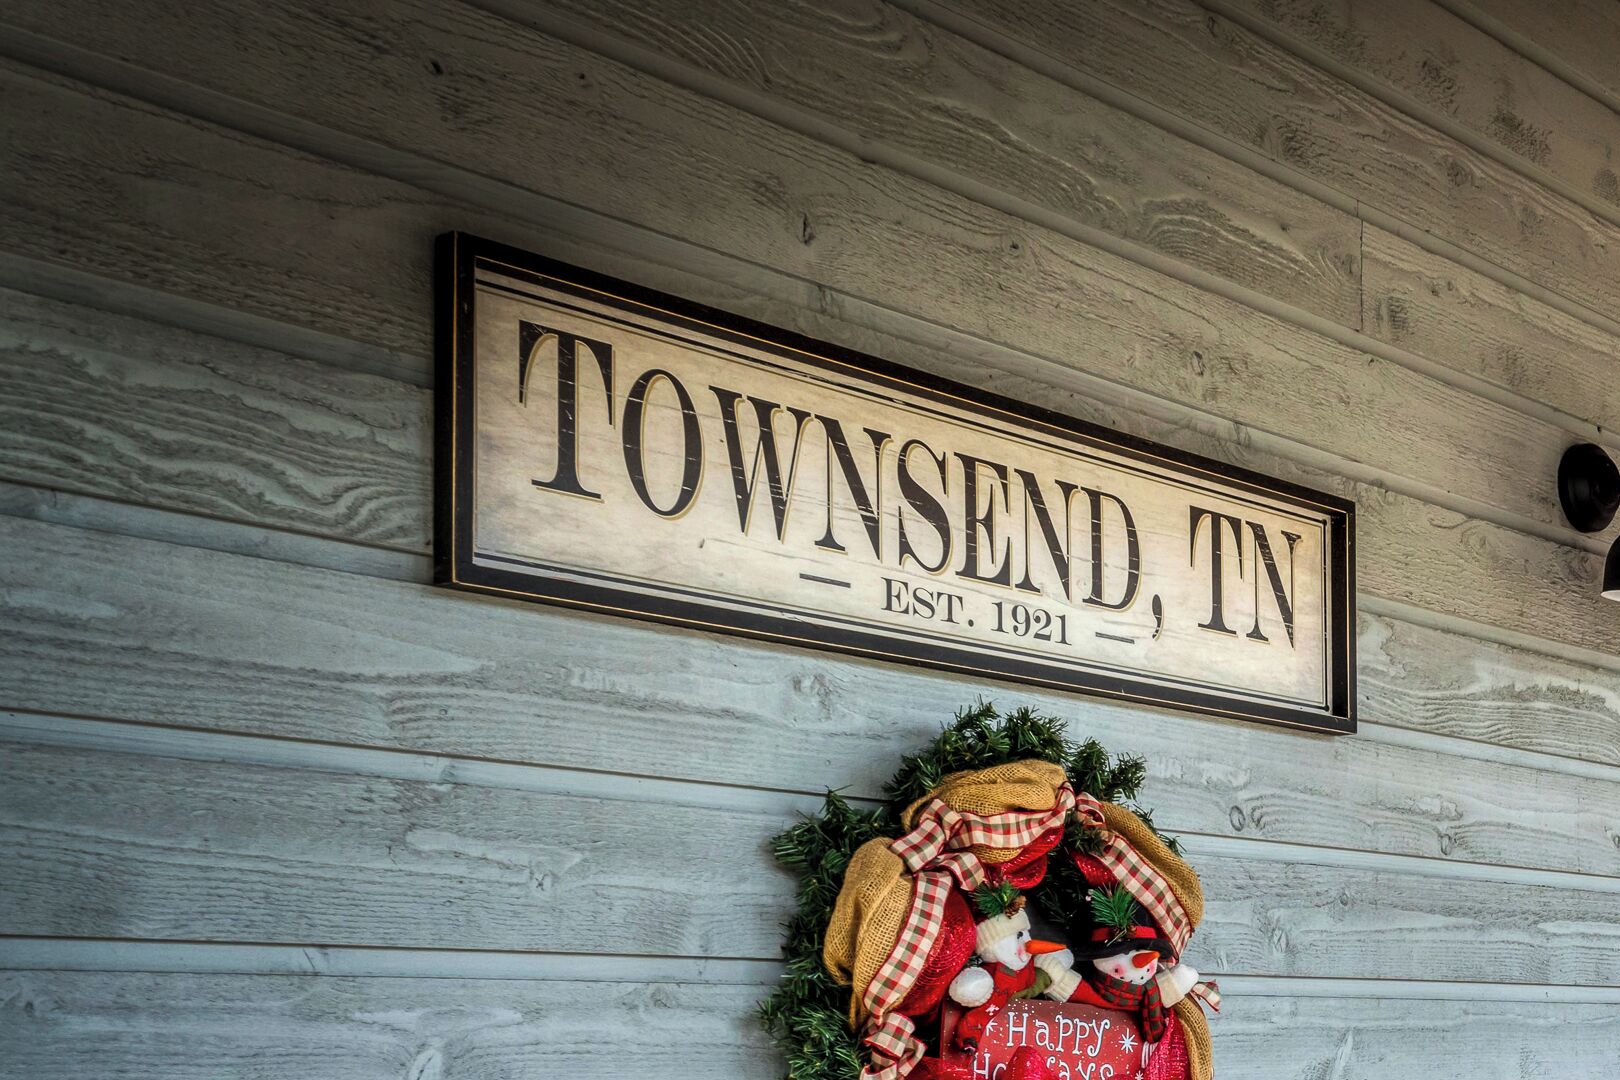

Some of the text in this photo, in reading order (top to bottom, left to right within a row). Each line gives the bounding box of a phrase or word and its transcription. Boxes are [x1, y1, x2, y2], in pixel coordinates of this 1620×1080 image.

[519, 319, 1302, 650] TOWNSEND, TN
[881, 576, 1073, 647] EST. 1921
